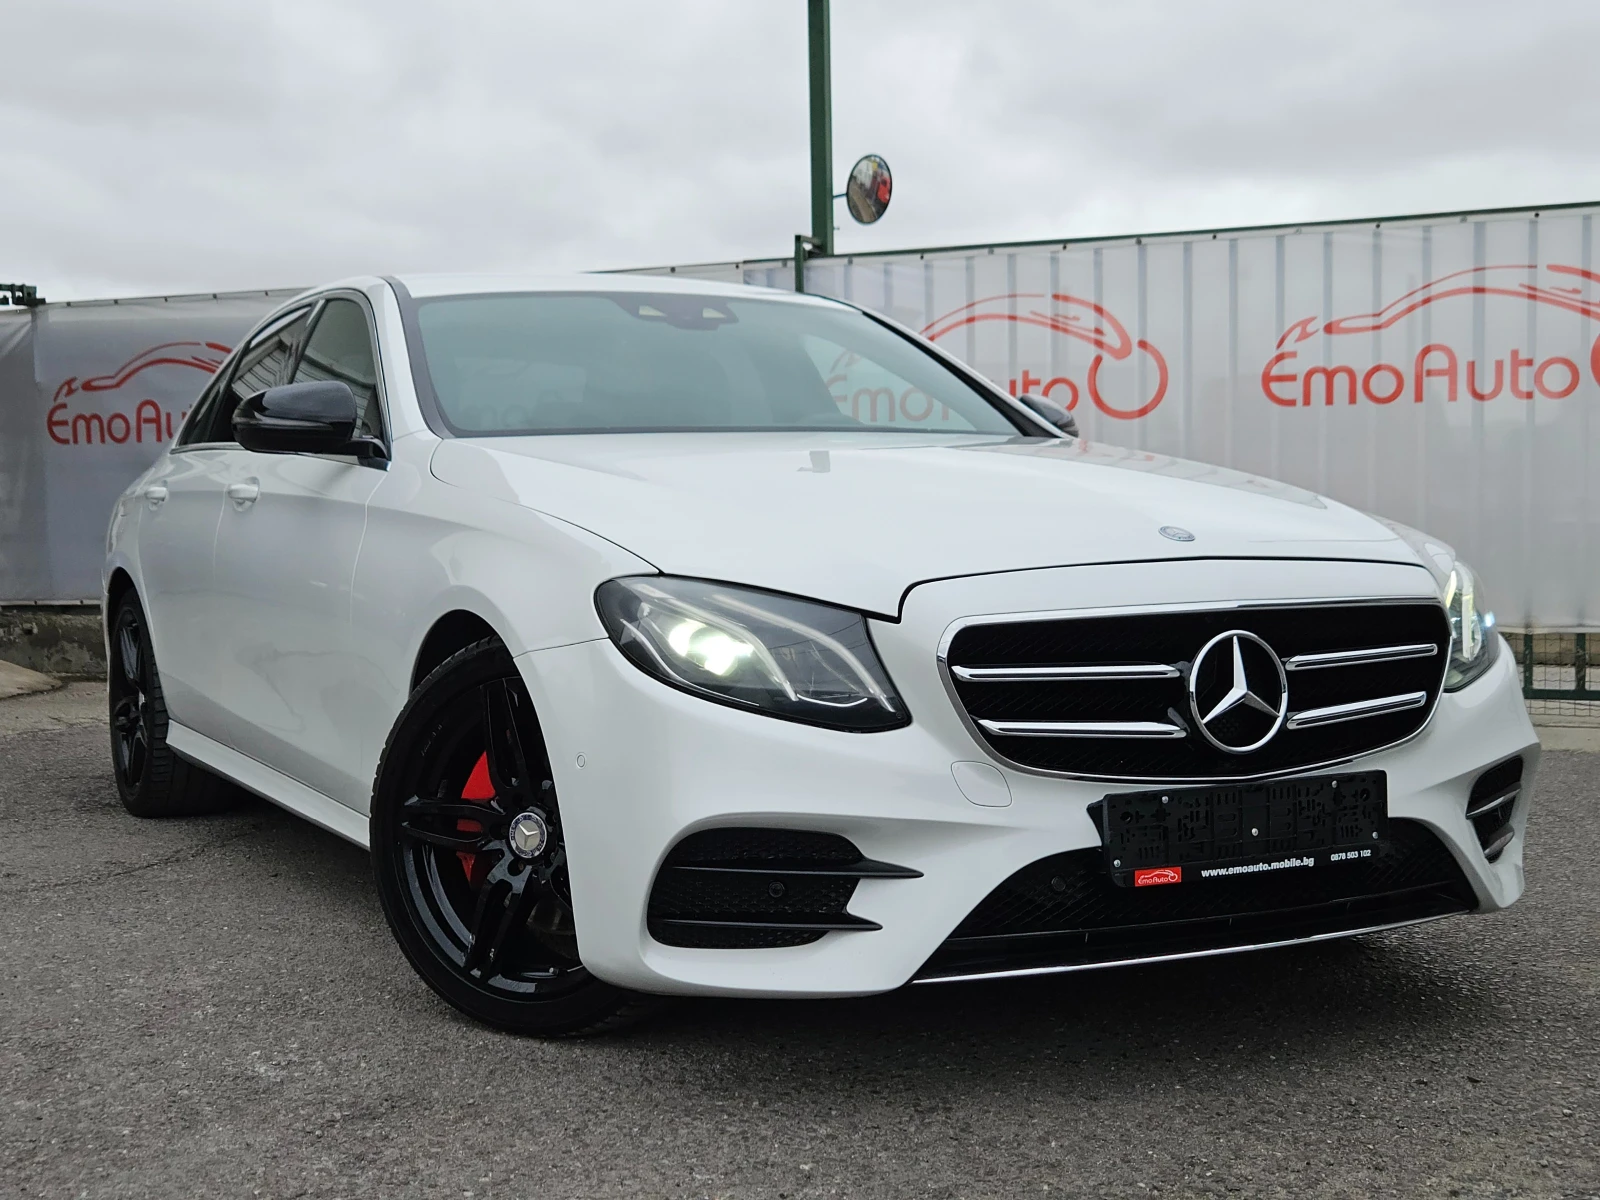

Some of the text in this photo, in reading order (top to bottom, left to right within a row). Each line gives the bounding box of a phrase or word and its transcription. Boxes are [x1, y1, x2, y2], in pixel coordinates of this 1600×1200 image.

[1261, 343, 1580, 407] EmoAuto
[1201, 857, 1315, 877] www.emoauto.mobile.bg
[1347, 851, 1359, 859] 503
